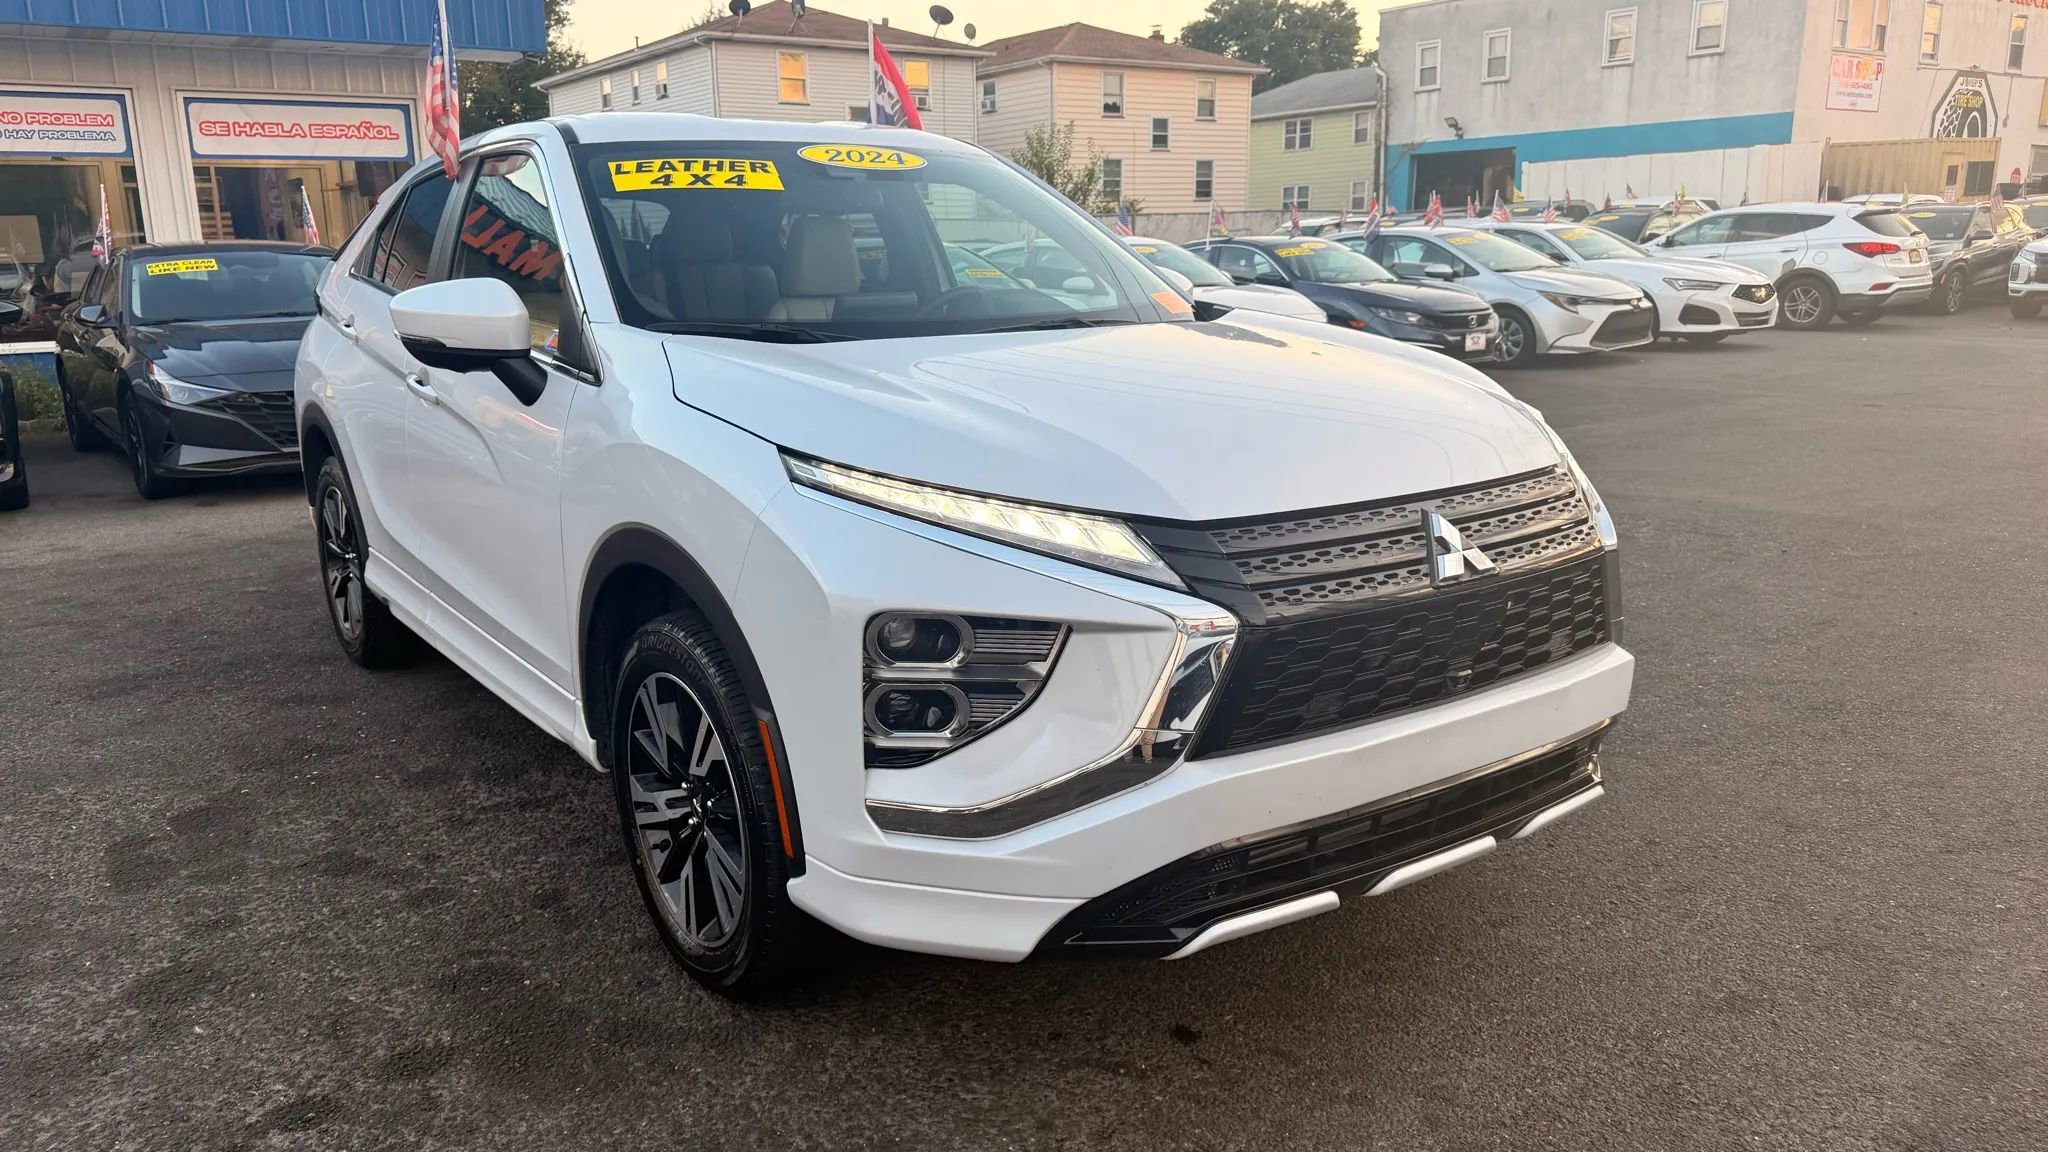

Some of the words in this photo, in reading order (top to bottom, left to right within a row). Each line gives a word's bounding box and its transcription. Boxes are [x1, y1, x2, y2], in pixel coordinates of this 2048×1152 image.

[1832, 59, 1853, 78] CAR
[1855, 60, 1882, 80] SP
[1955, 94, 1967, 107] TIRE
[1968, 95, 1984, 108] SHOP
[25, 112, 115, 127] PROBLEM
[4, 129, 36, 139] HAY
[38, 129, 117, 140] PROBLEMA
[200, 121, 230, 136] SE
[233, 122, 306, 138] HABLA
[308, 121, 400, 140] ESPAÑOL
[824, 149, 908, 165] 2024
[614, 159, 773, 176] LEATHER
